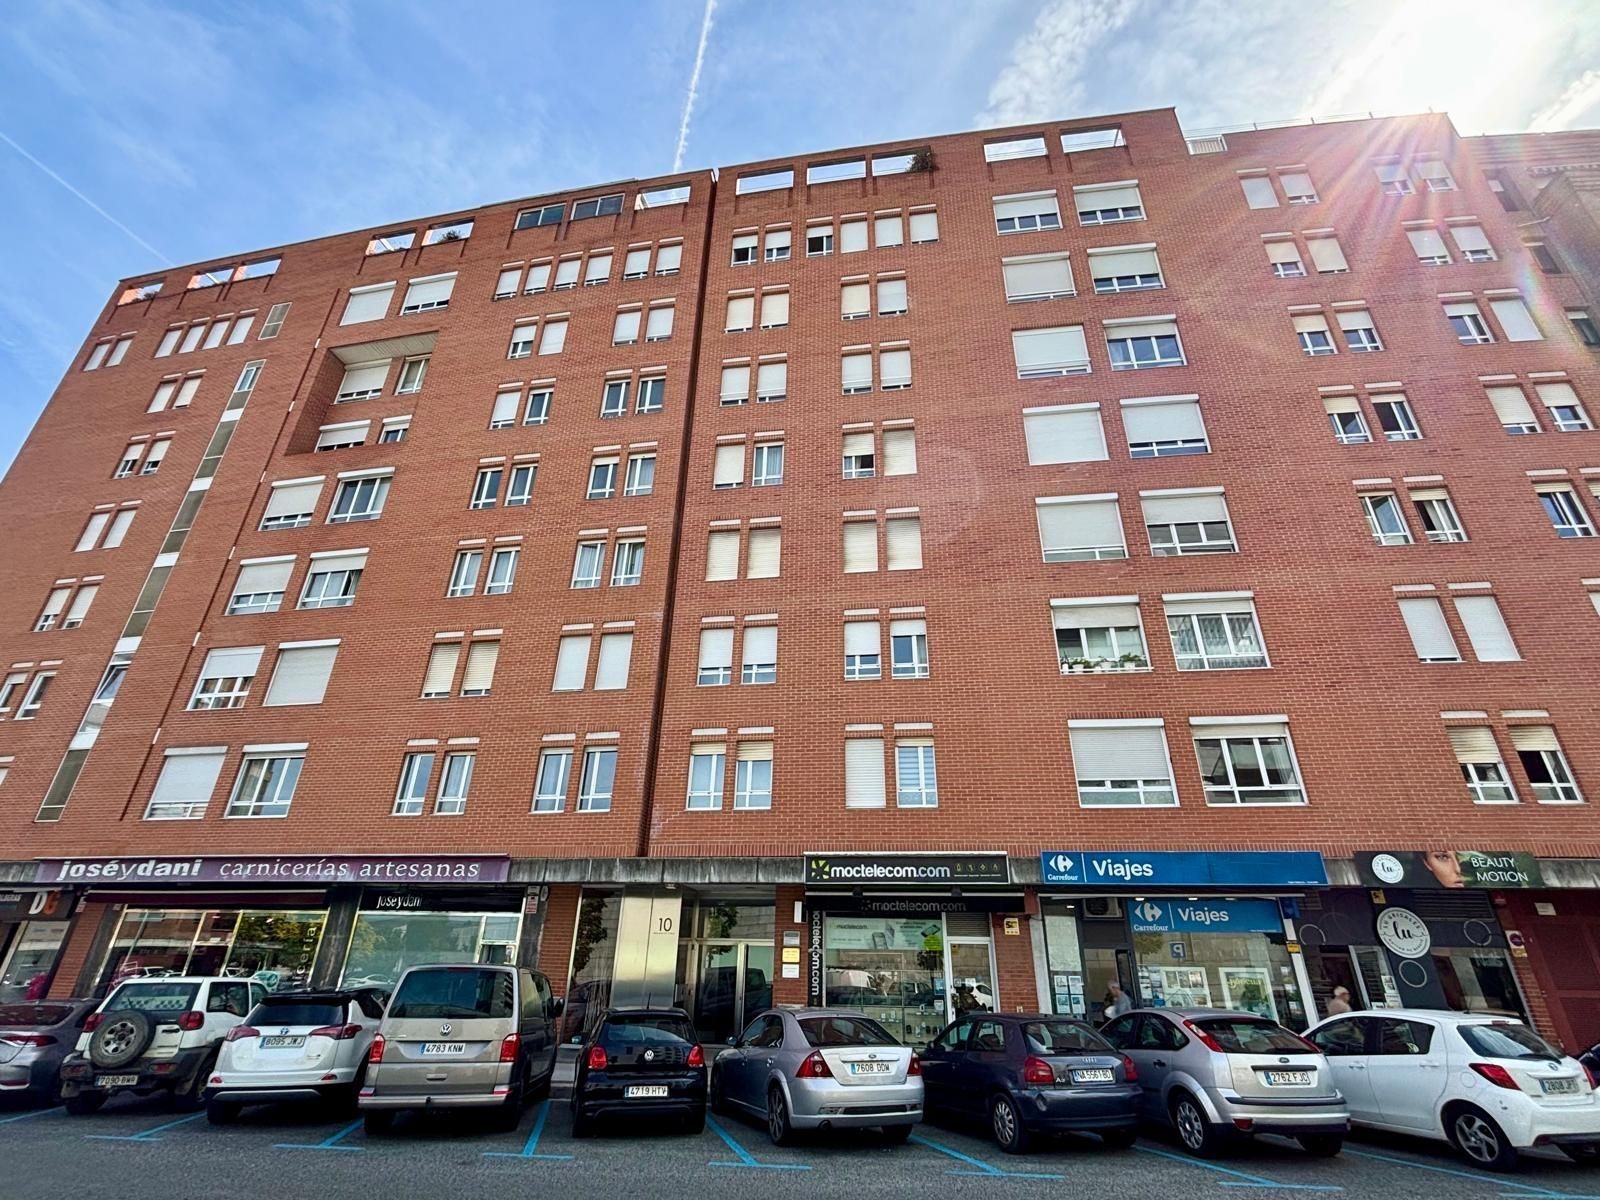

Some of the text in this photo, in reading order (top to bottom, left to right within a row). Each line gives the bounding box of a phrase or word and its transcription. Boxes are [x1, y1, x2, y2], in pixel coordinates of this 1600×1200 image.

[1470, 857, 1515, 868] BEAUTY
[219, 859, 348, 878] carnicerías
[359, 861, 480, 878] artesanas
[830, 863, 951, 878] moctelecom.com
[1092, 858, 1154, 881] Viajes
[1047, 873, 1079, 881] Carrefour
[1476, 871, 1529, 882] MOTION
[872, 901, 967, 912] moctelecom.com
[1178, 906, 1230, 925] Viajes
[658, 917, 673, 932] 10
[1133, 924, 1168, 932] Carrefour
[856, 1063, 874, 1072] 7608
[630, 1087, 650, 1096] 4719
